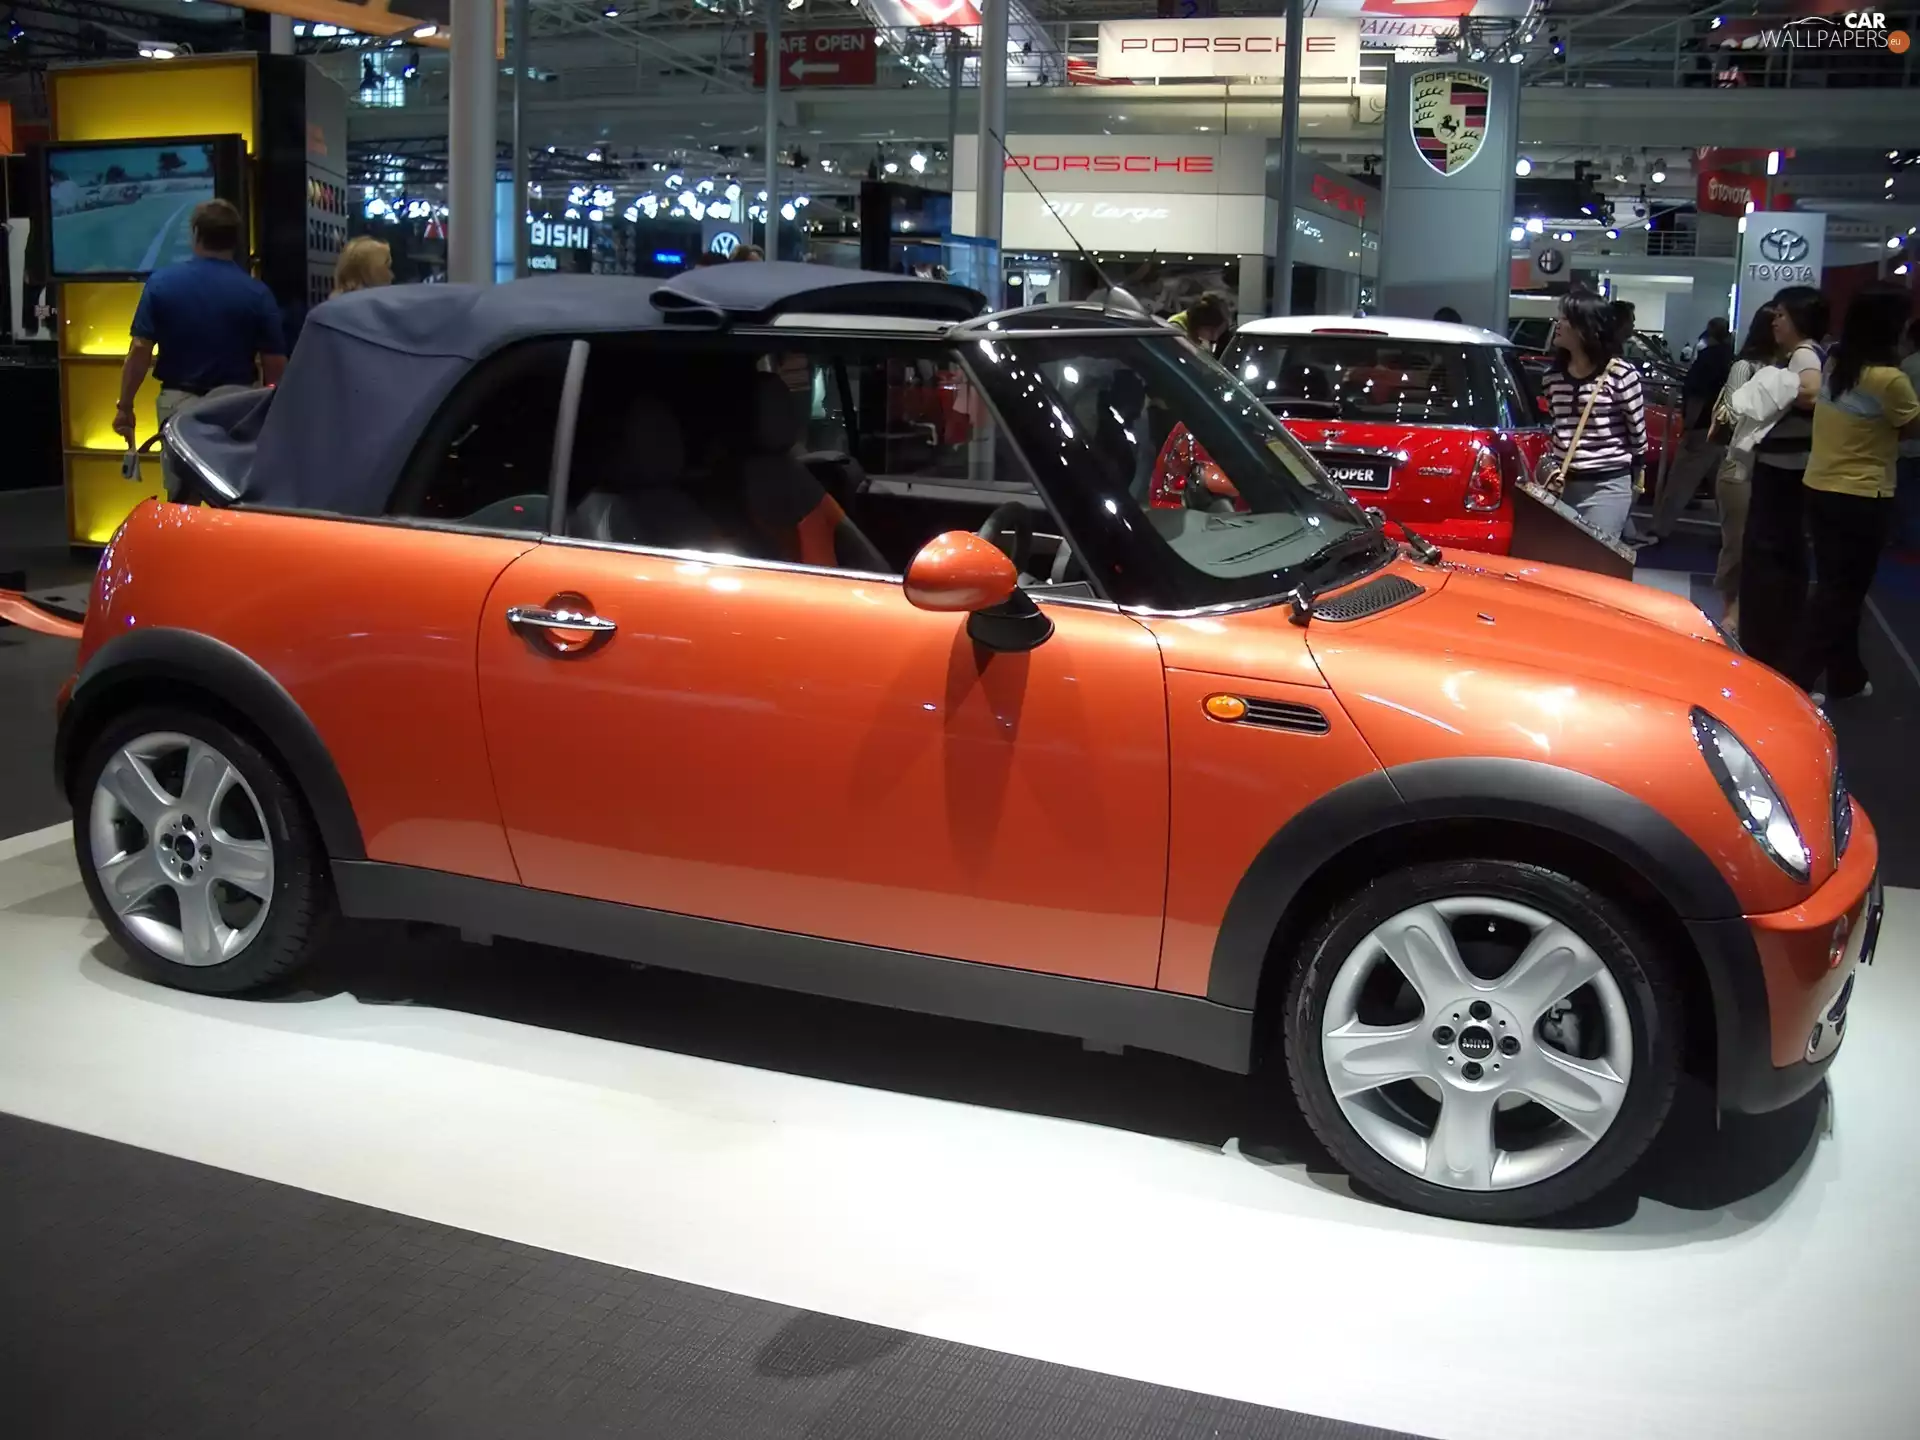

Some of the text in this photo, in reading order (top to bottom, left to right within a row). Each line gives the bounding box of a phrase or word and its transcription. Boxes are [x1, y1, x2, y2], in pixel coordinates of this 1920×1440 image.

[815, 34, 866, 52] OPEN
[1121, 37, 1336, 53] PORSCHE
[1004, 155, 1214, 173] PORSCHE
[531, 221, 589, 249] BISHI
[1748, 264, 1815, 282] TOYOTA
[1327, 466, 1374, 482] OOPER
